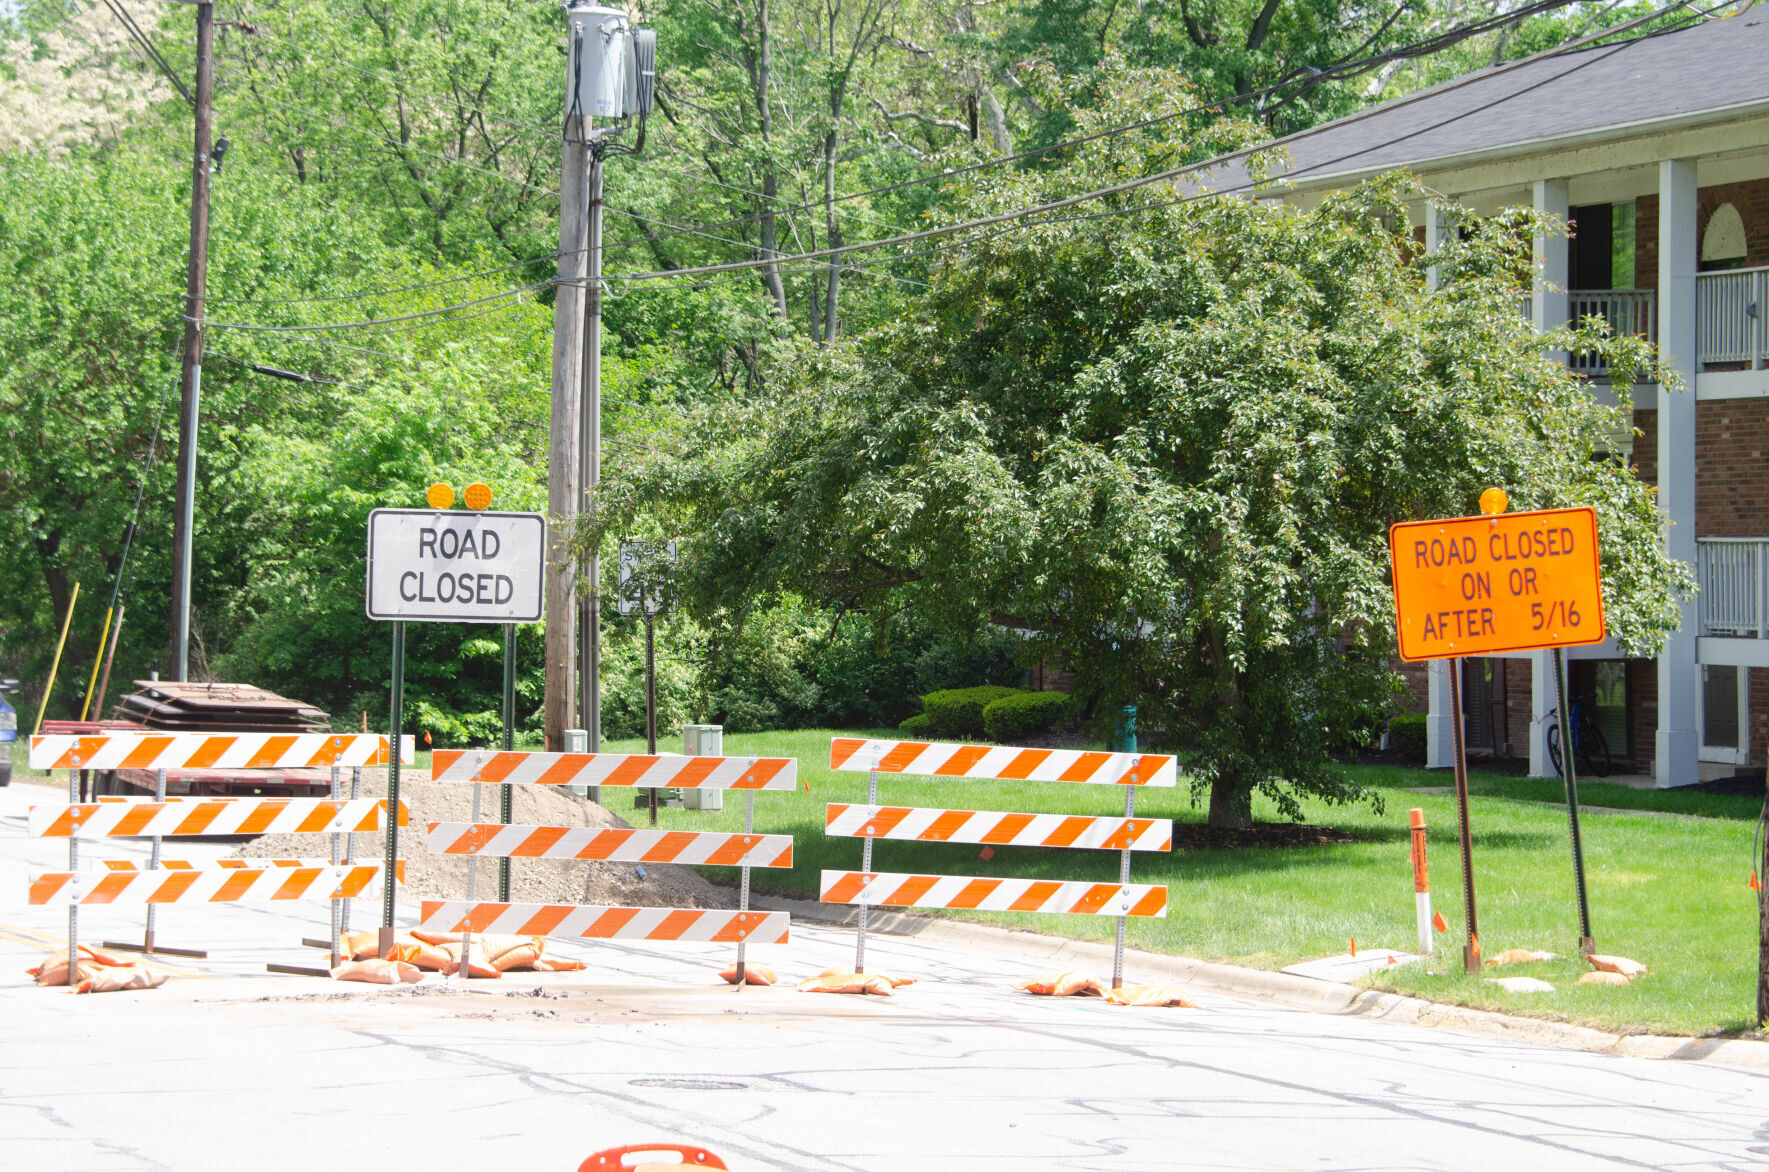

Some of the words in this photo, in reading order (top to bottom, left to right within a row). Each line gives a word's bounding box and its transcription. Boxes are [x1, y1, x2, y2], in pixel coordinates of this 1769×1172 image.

[419, 528, 500, 559] ROAD
[1415, 537, 1476, 568] ROAD
[1490, 528, 1573, 561] CLOSED
[399, 571, 513, 604] CLOSED
[1462, 572, 1490, 600] ON
[1509, 568, 1538, 596] OR
[1423, 608, 1495, 641] AFTER
[1532, 601, 1580, 631] 5/16
